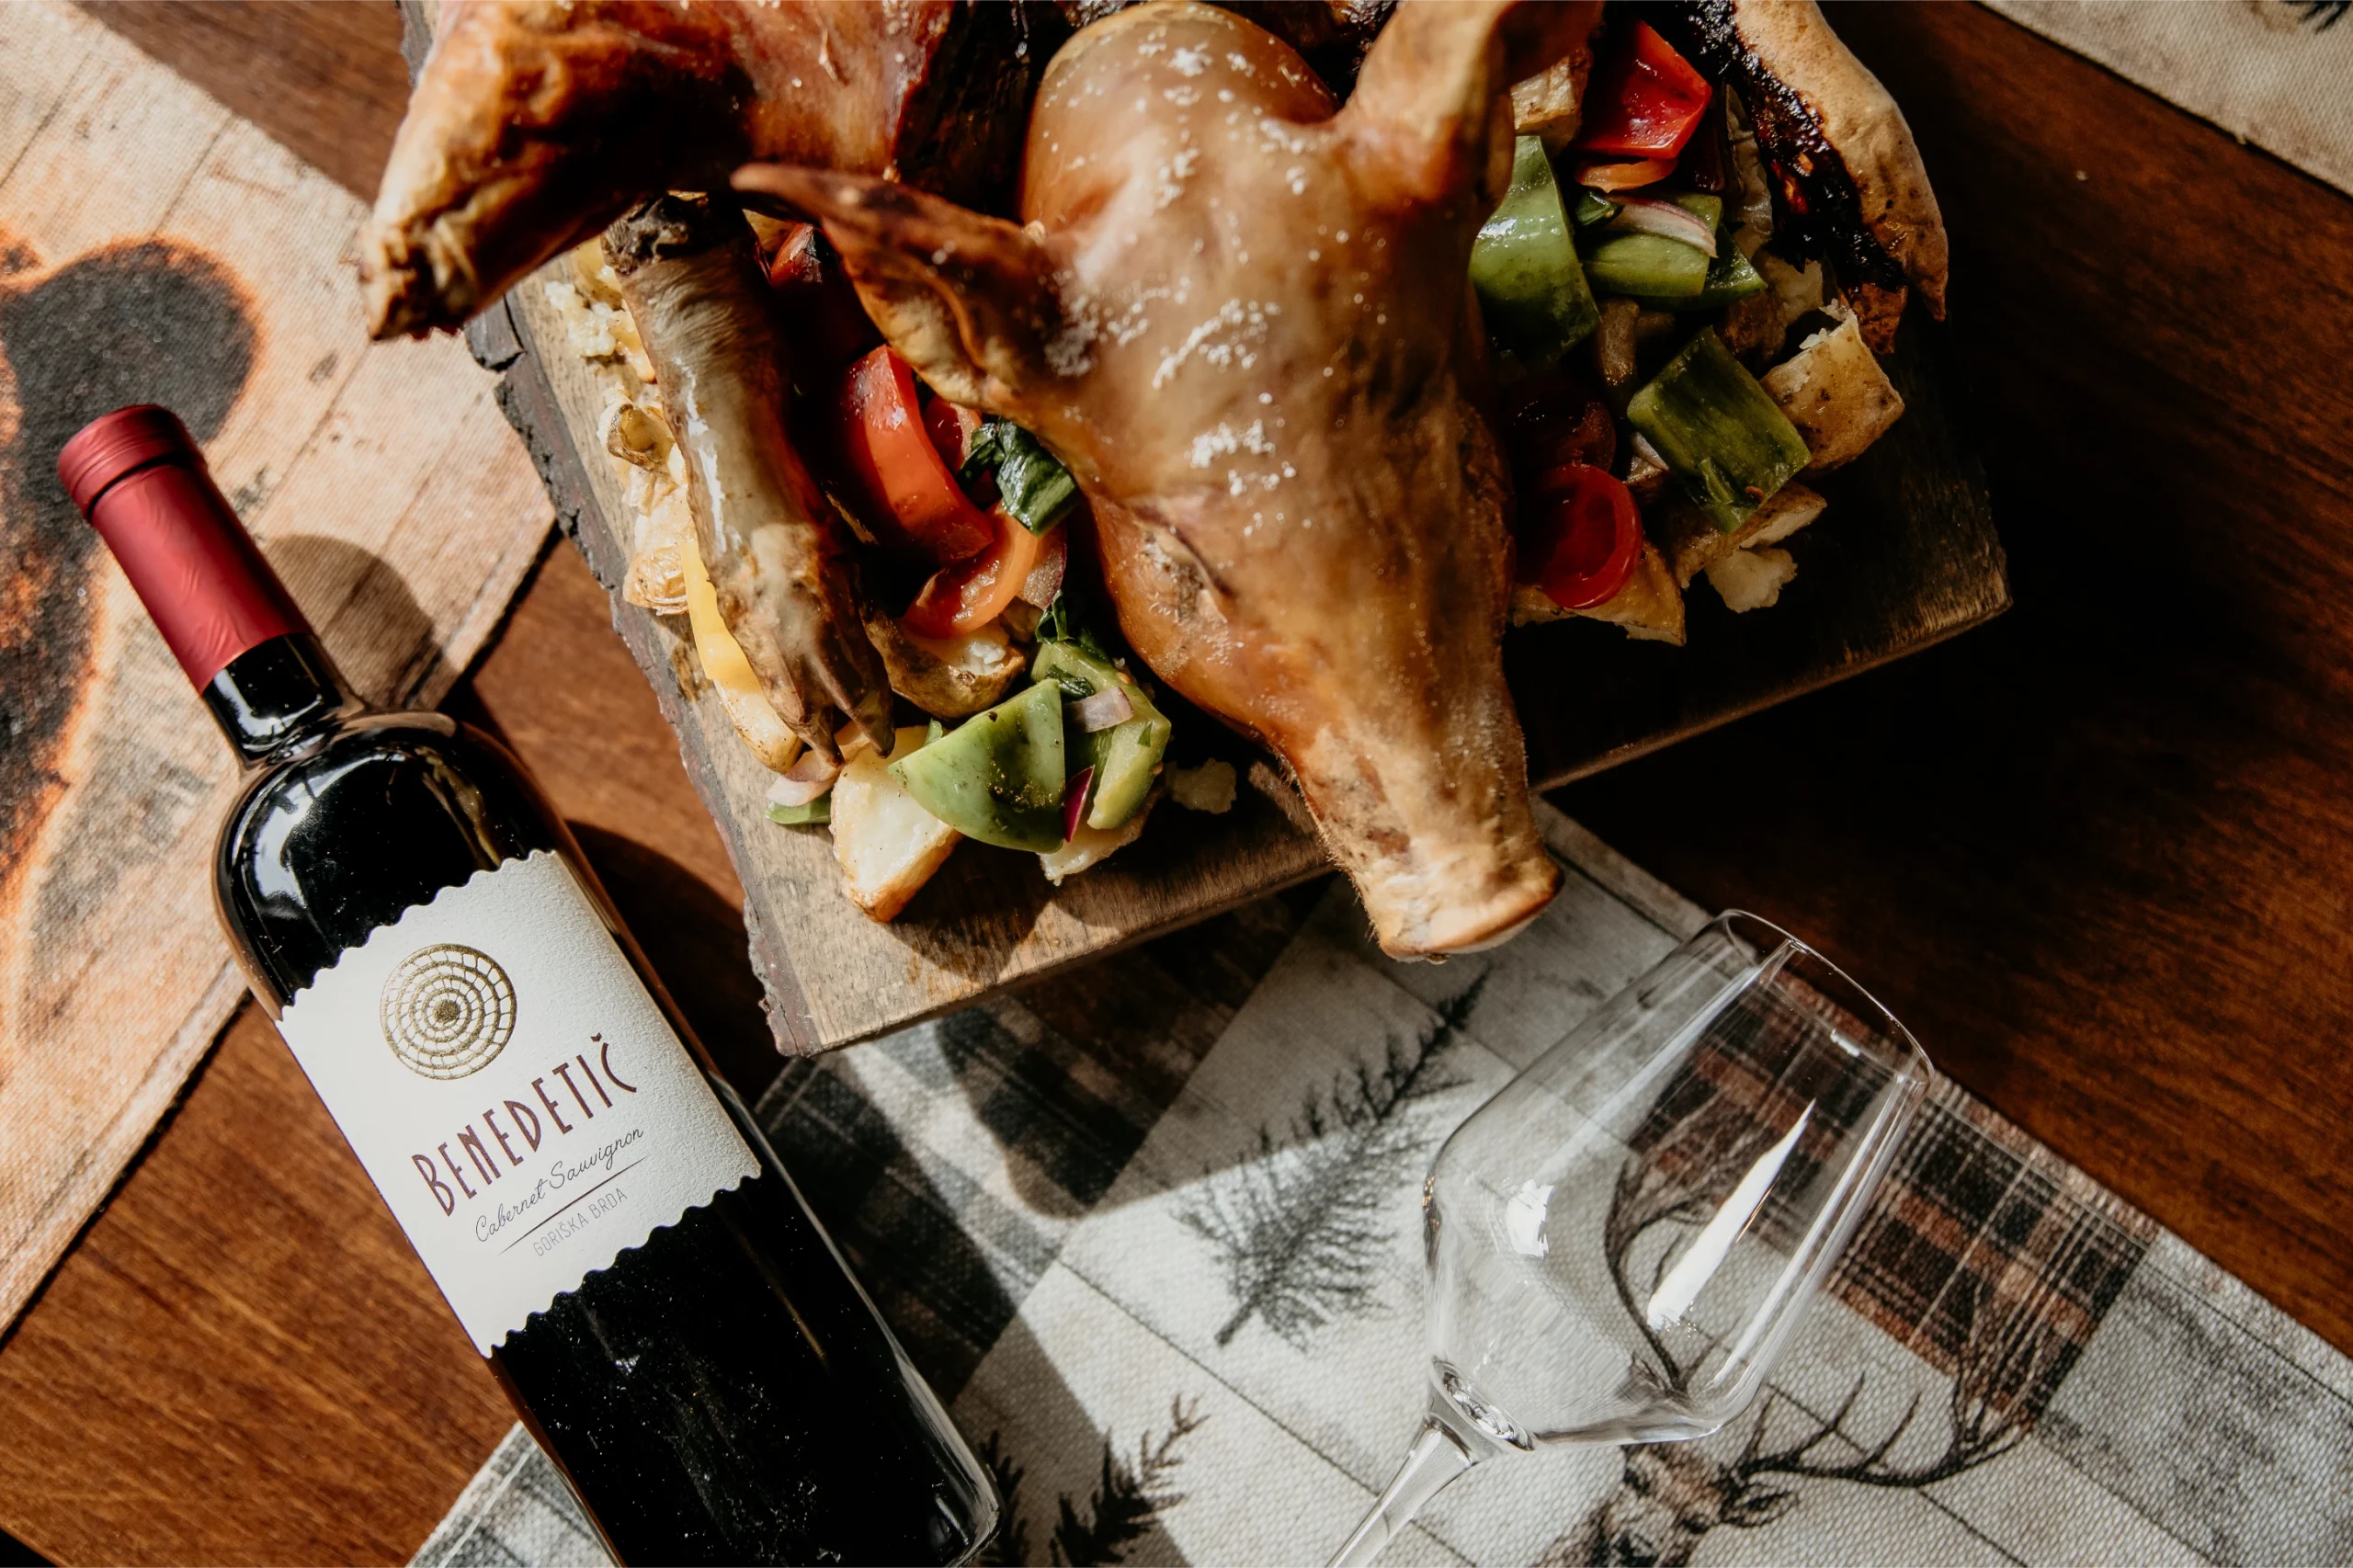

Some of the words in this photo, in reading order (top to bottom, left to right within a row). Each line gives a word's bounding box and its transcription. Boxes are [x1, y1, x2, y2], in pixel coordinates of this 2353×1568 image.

[411, 1032, 637, 1217] BENEDETIČ
[475, 1177, 549, 1243] Cabernet
[549, 1128, 644, 1189] Sauvignon
[533, 1212, 589, 1256] GORIŠKA
[588, 1187, 628, 1220] BRDA
